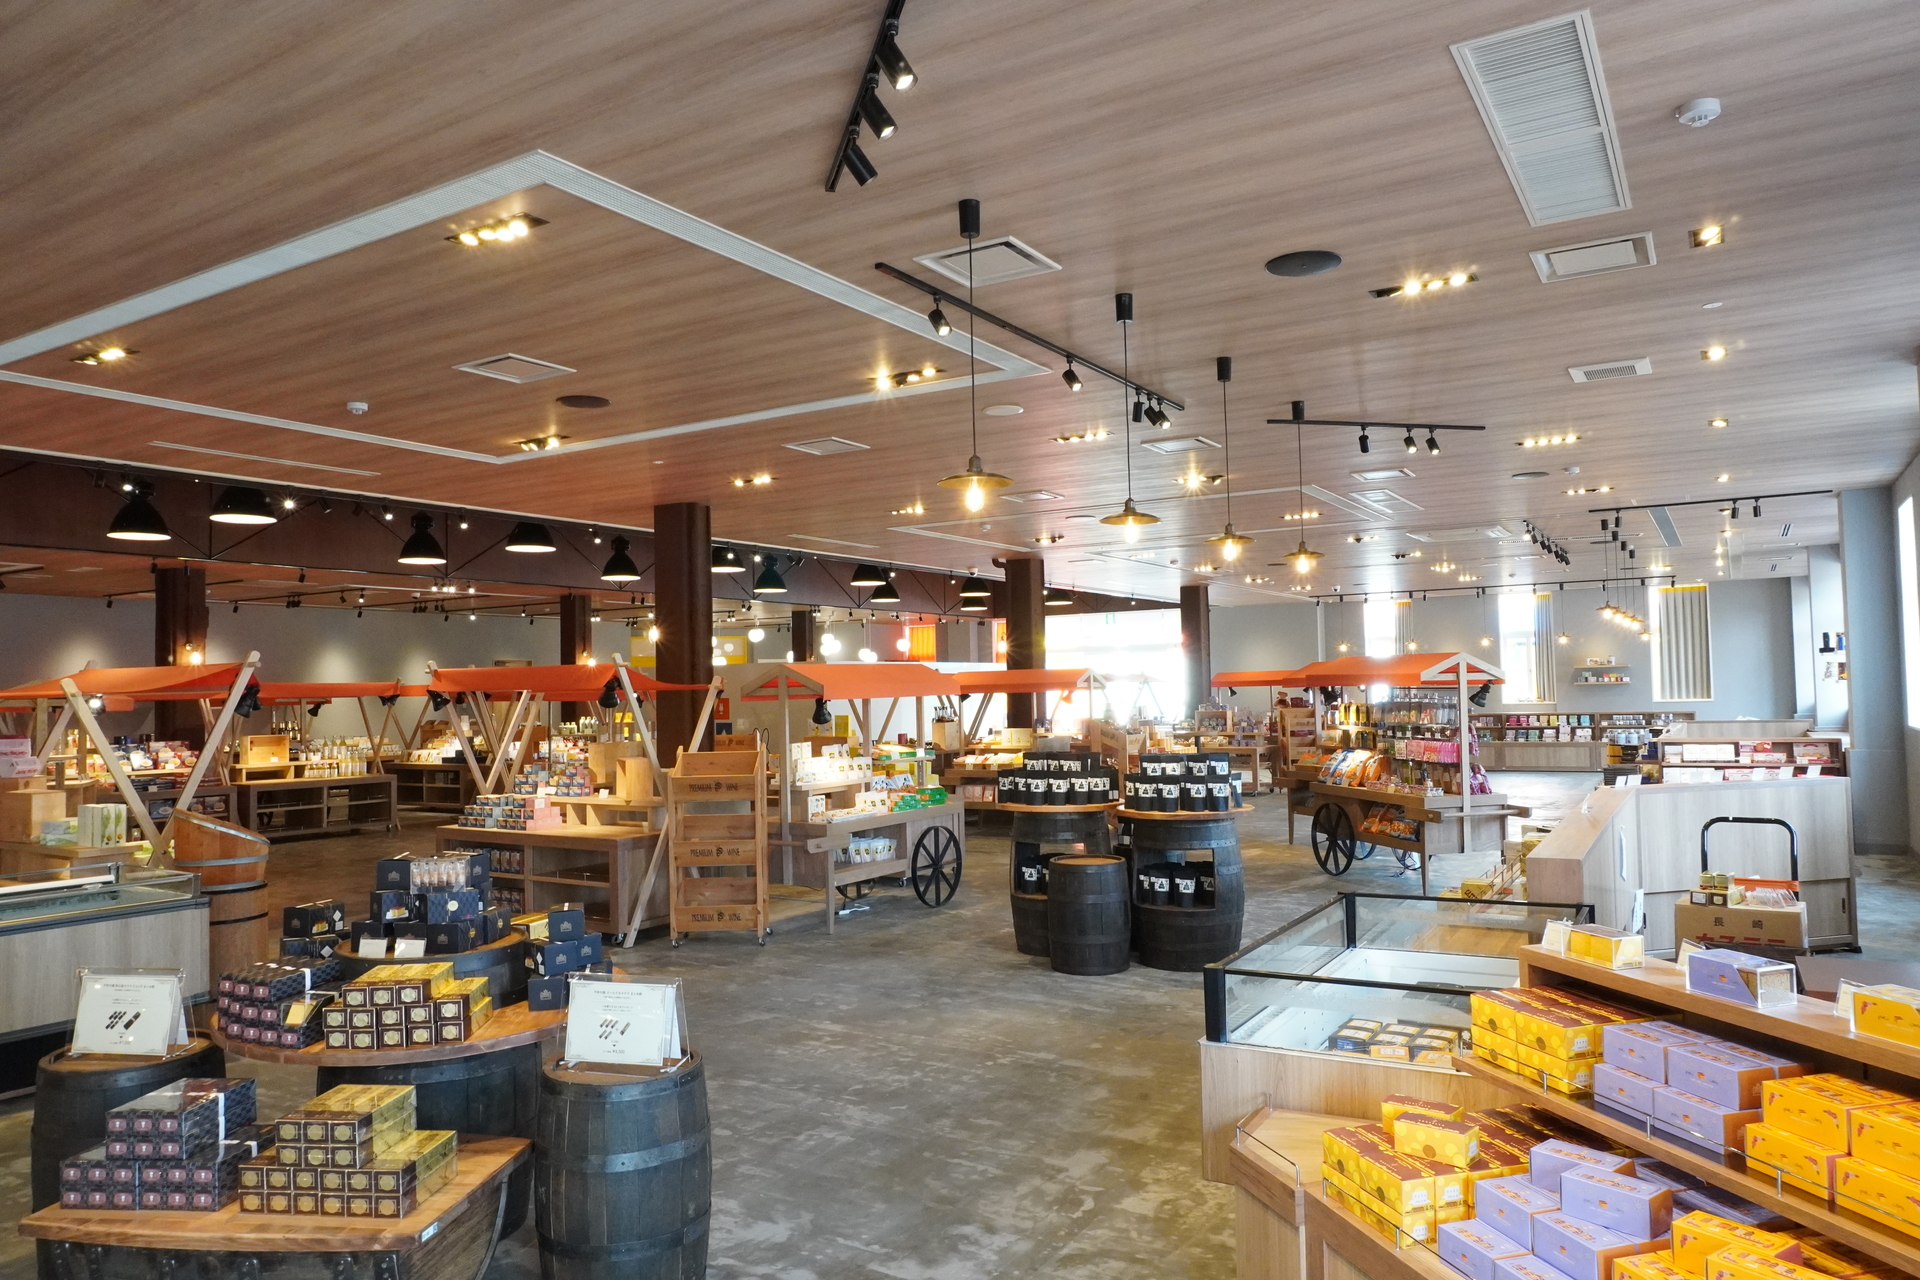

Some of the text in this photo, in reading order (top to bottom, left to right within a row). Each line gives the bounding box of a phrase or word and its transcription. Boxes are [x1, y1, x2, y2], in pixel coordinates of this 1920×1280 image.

[689, 783, 738, 792] PREMIUM WINE
[690, 848, 740, 857] PREMIUM WINE
[691, 913, 741, 922] PREMIUM WINE
